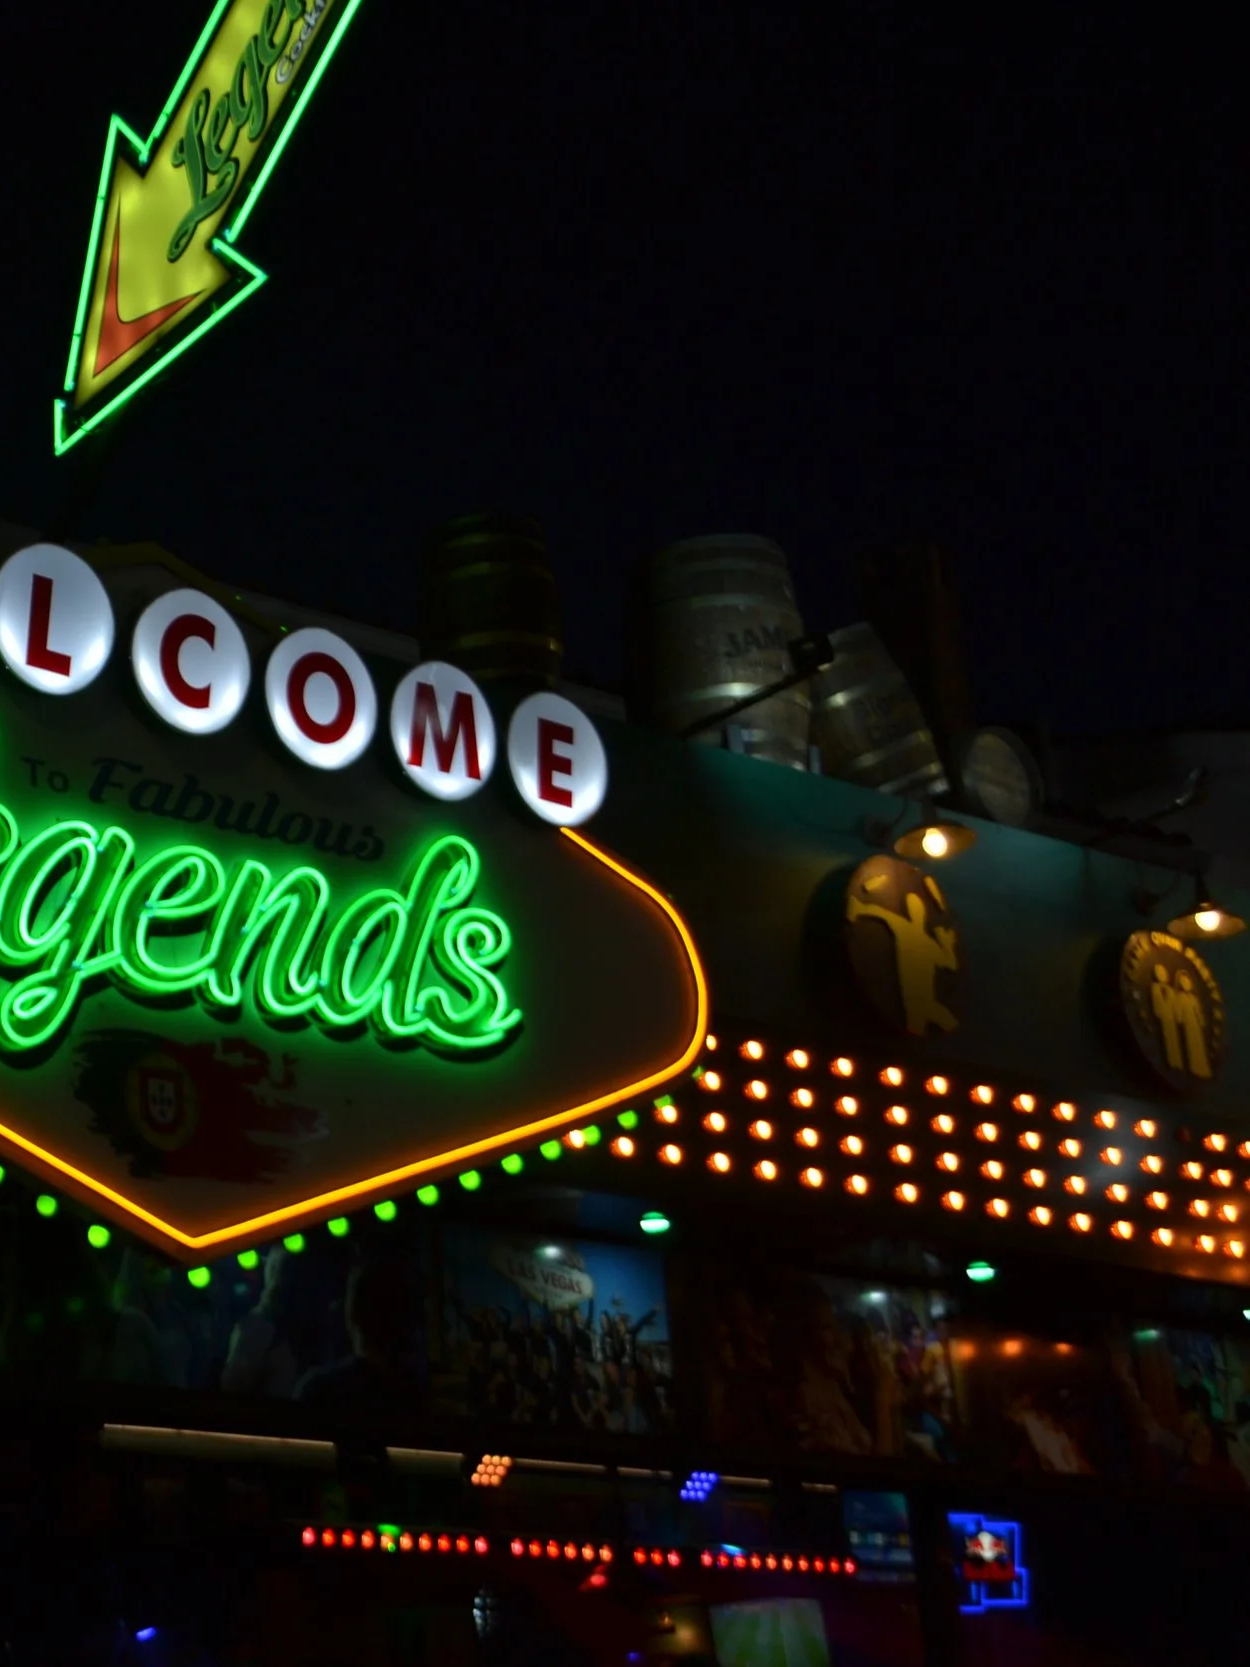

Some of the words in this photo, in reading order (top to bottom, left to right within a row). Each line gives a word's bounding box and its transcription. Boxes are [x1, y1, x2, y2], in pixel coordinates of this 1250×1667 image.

[22, 756, 70, 794] To
[88, 756, 385, 862] Fabulous
[540, 1268, 582, 1295] VEGAS
